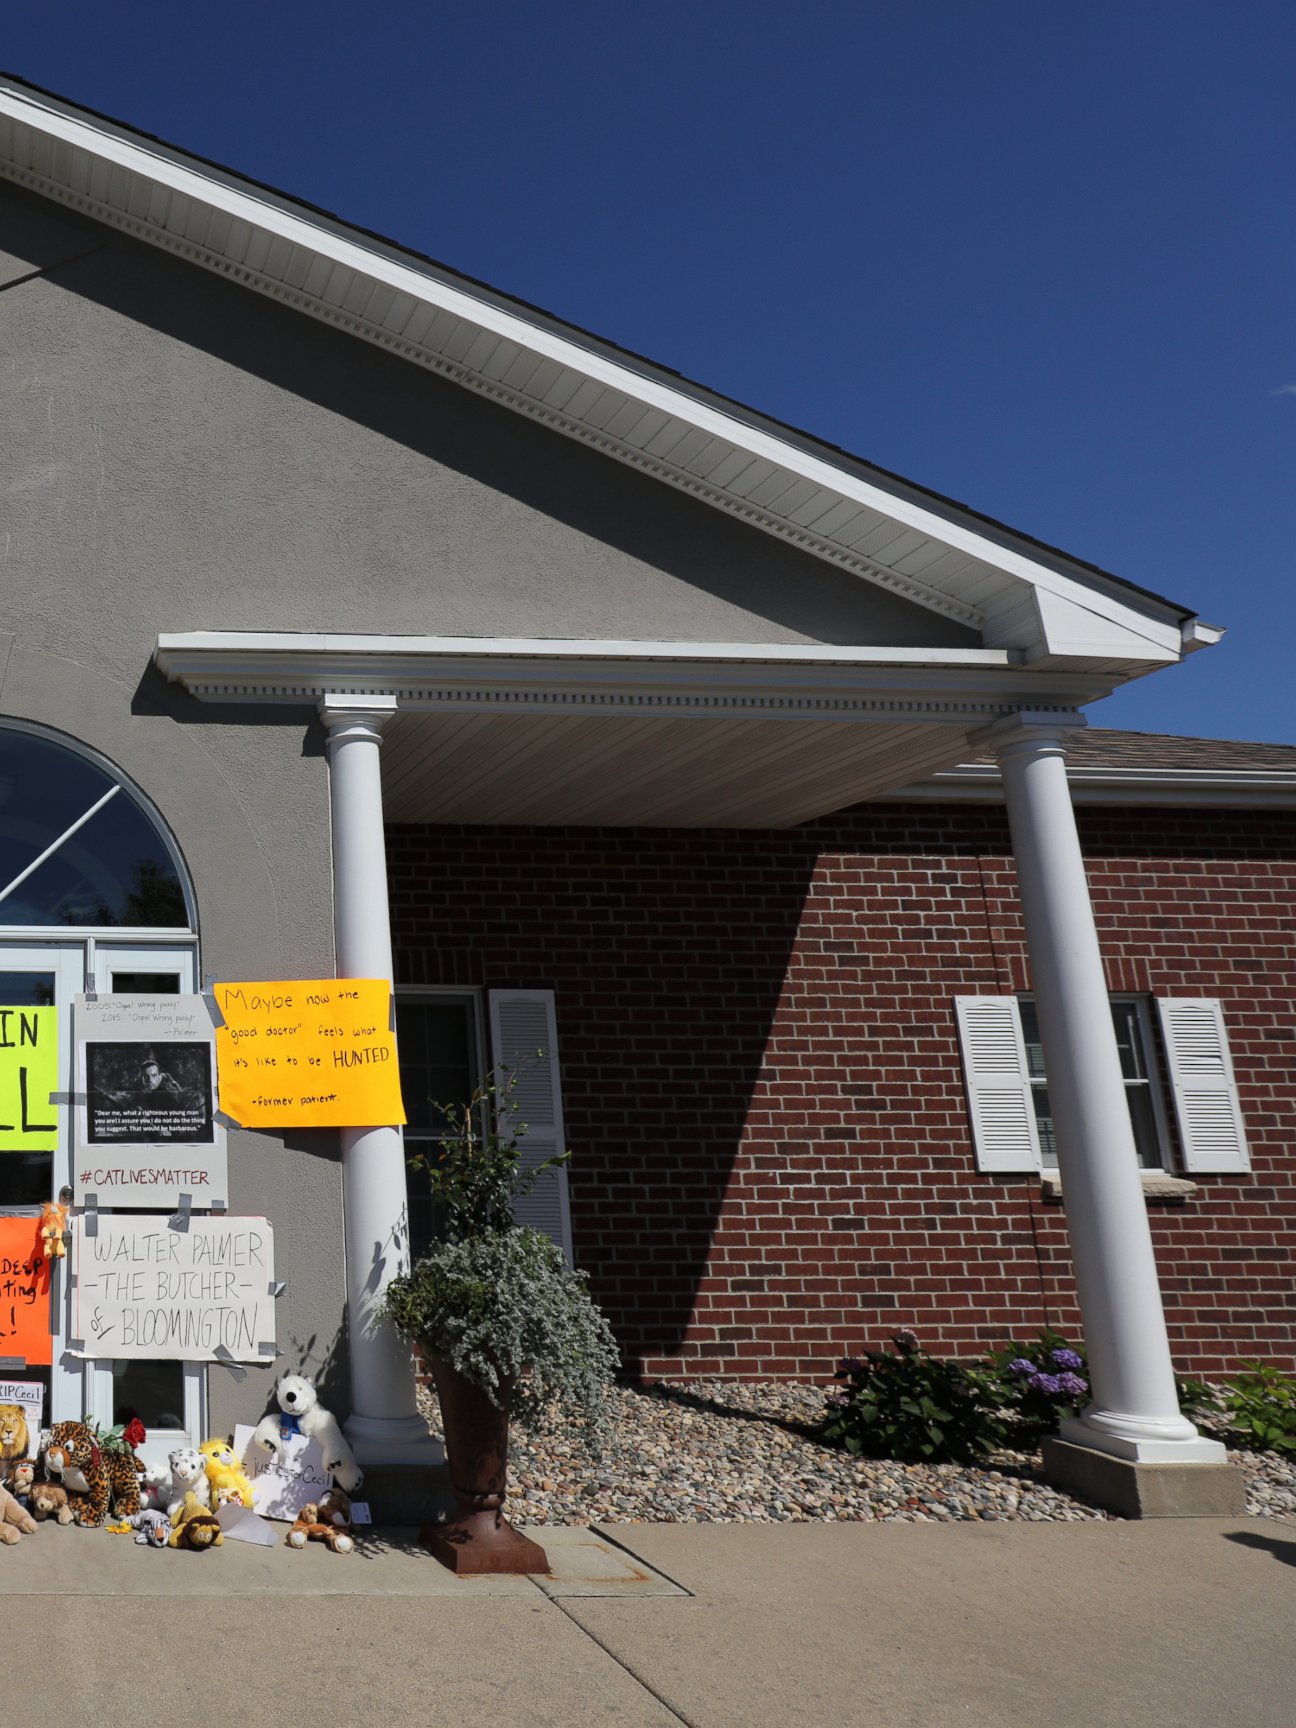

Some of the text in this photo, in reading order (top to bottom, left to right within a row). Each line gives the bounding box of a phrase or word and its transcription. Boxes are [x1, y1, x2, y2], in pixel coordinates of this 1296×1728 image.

[225, 989, 360, 1013] Maybe now the
[154, 1014, 172, 1025] Wrong
[266, 1024, 302, 1036] doctor"
[318, 1026, 344, 1036] feels
[353, 1026, 376, 1037] what
[256, 1057, 276, 1066] like
[286, 1056, 298, 1066] to
[308, 1056, 321, 1066] be
[334, 1047, 390, 1068] HUNTED
[80, 1168, 209, 1186] #CATLIVESMATTER
[94, 1232, 264, 1266] WALTER PALMER
[121, 1302, 258, 1349] BLOOMINGTON
[15, 1385, 40, 1399] Cecil
